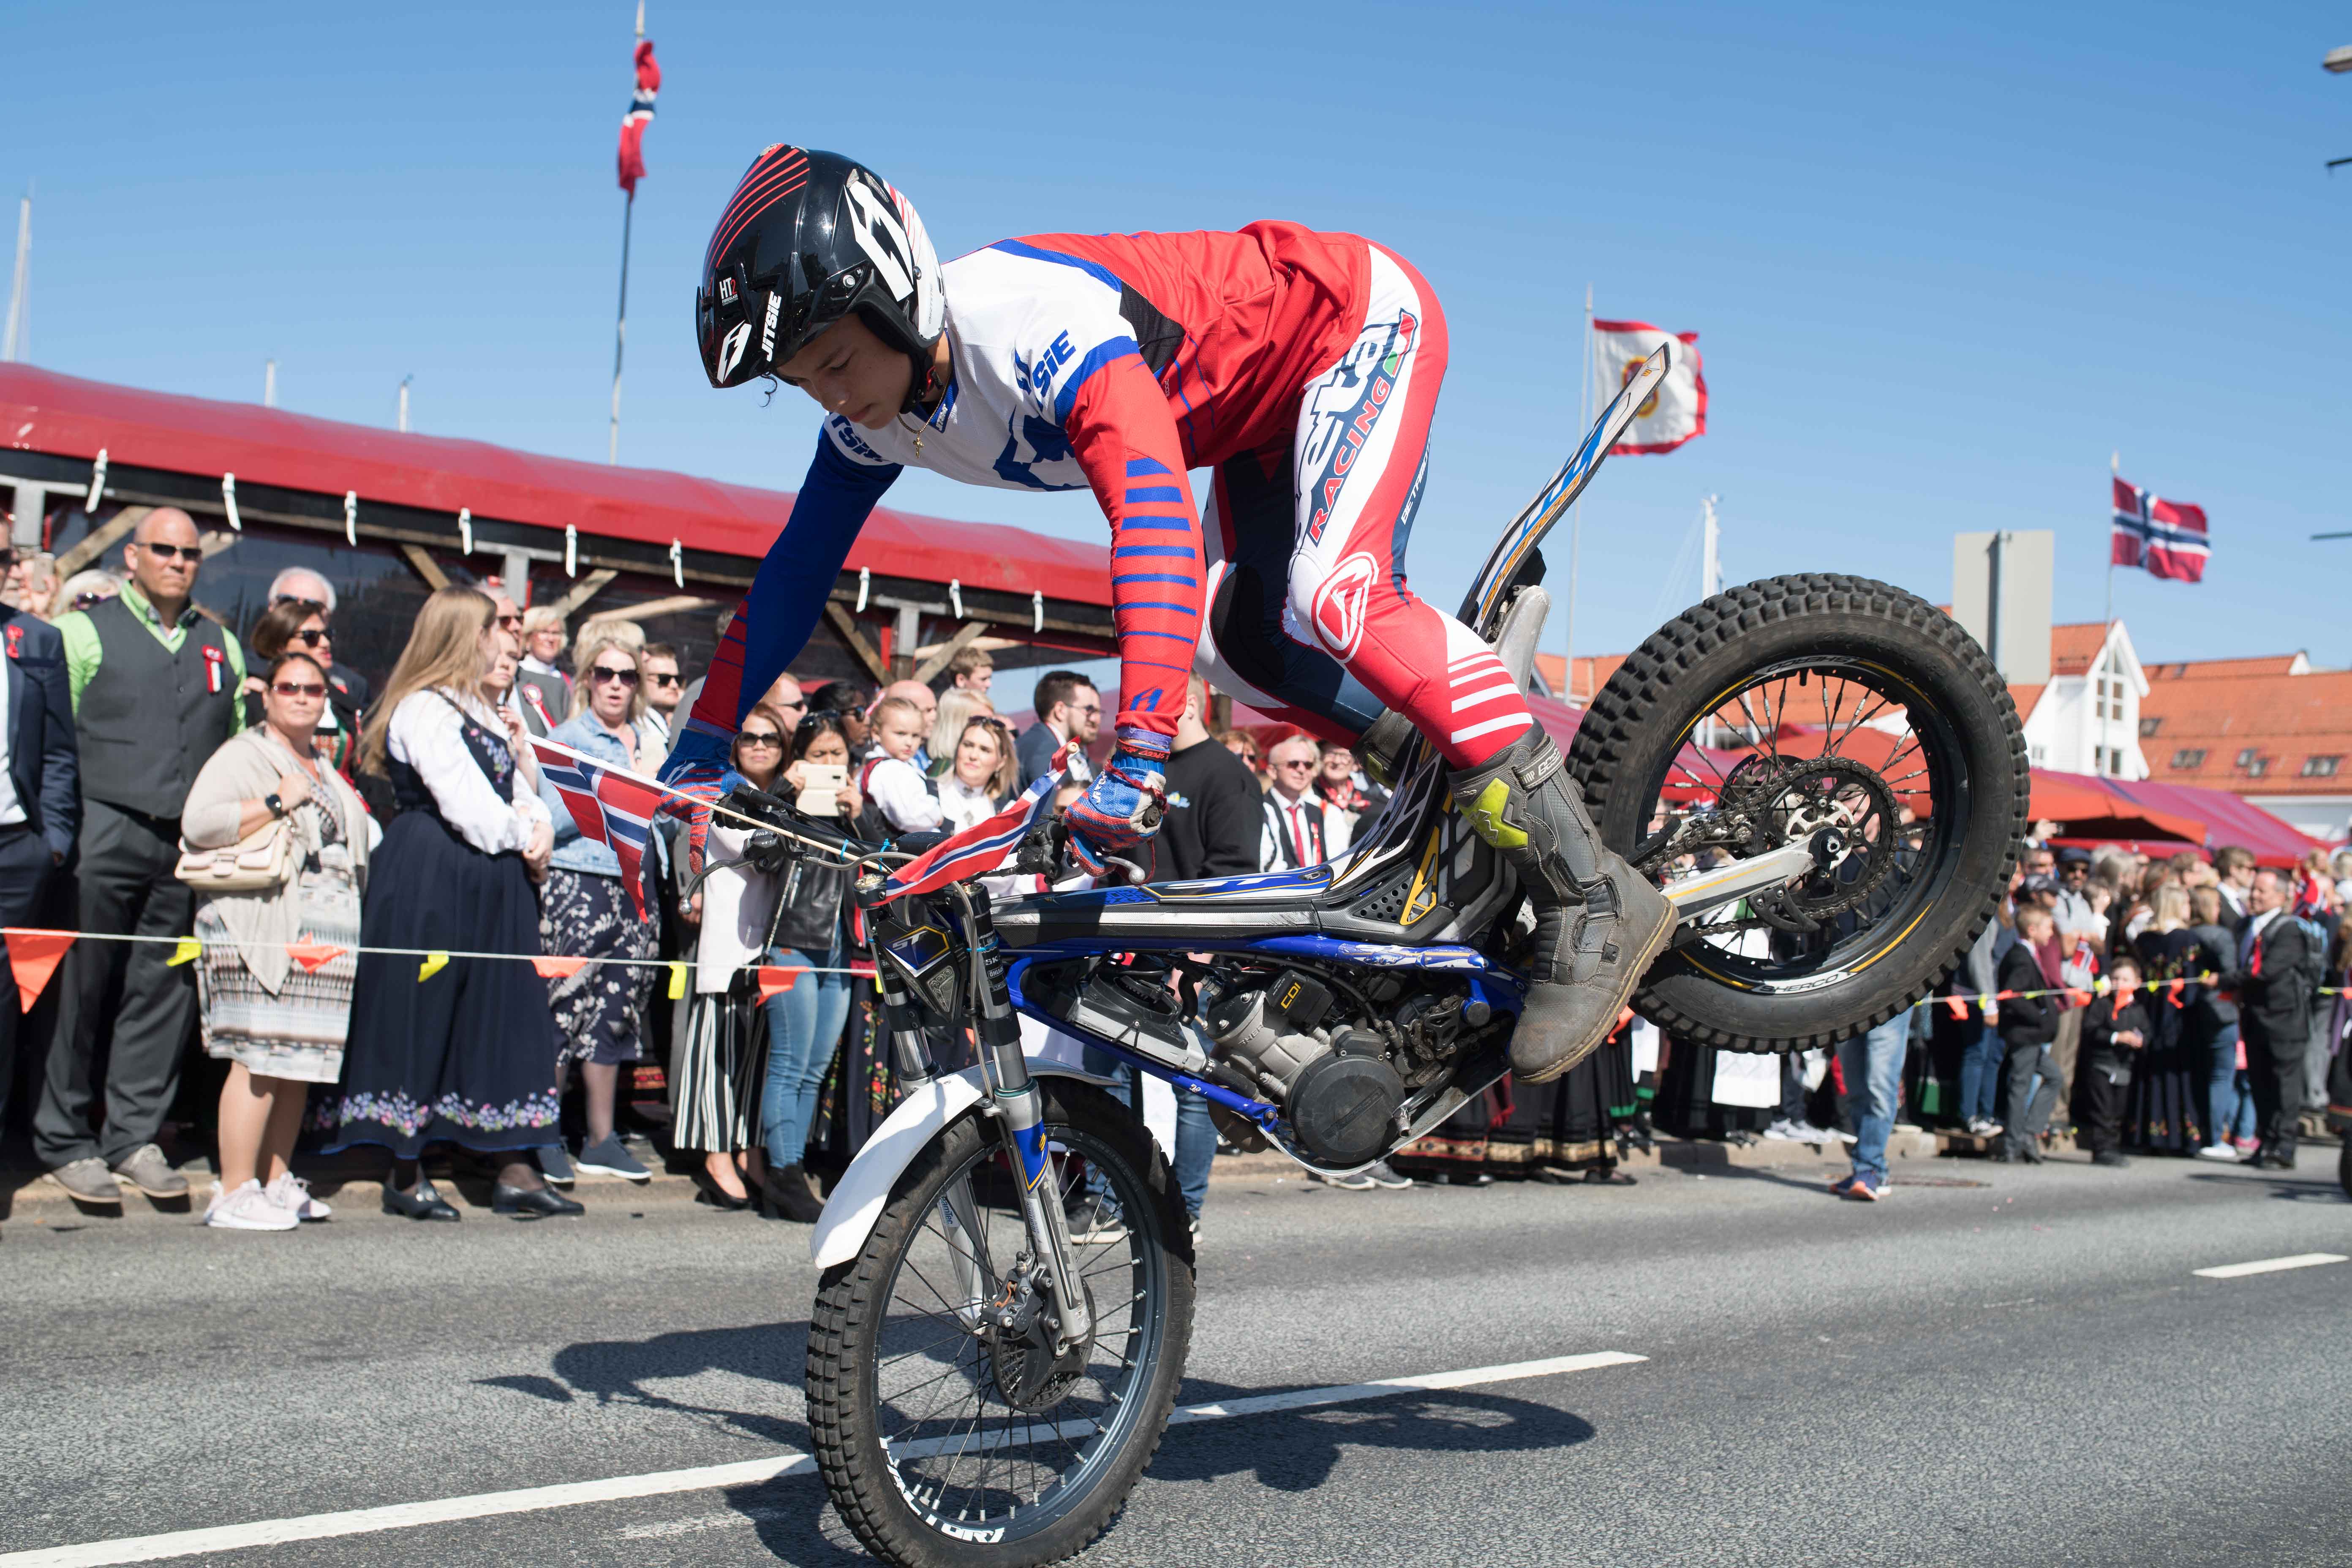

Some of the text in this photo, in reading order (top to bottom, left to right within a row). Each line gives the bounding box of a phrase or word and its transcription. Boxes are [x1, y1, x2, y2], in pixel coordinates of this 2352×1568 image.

[719, 277, 737, 299] HT2
[1310, 376, 1390, 543] RACING
[1767, 656, 1850, 673] SHERCO
[892, 930, 928, 951] ST
[985, 955, 1001, 966] SK
[1759, 974, 1839, 992] SHERCO
[1280, 982, 1301, 1009] CDI
[938, 1197, 953, 1225] eamTec
